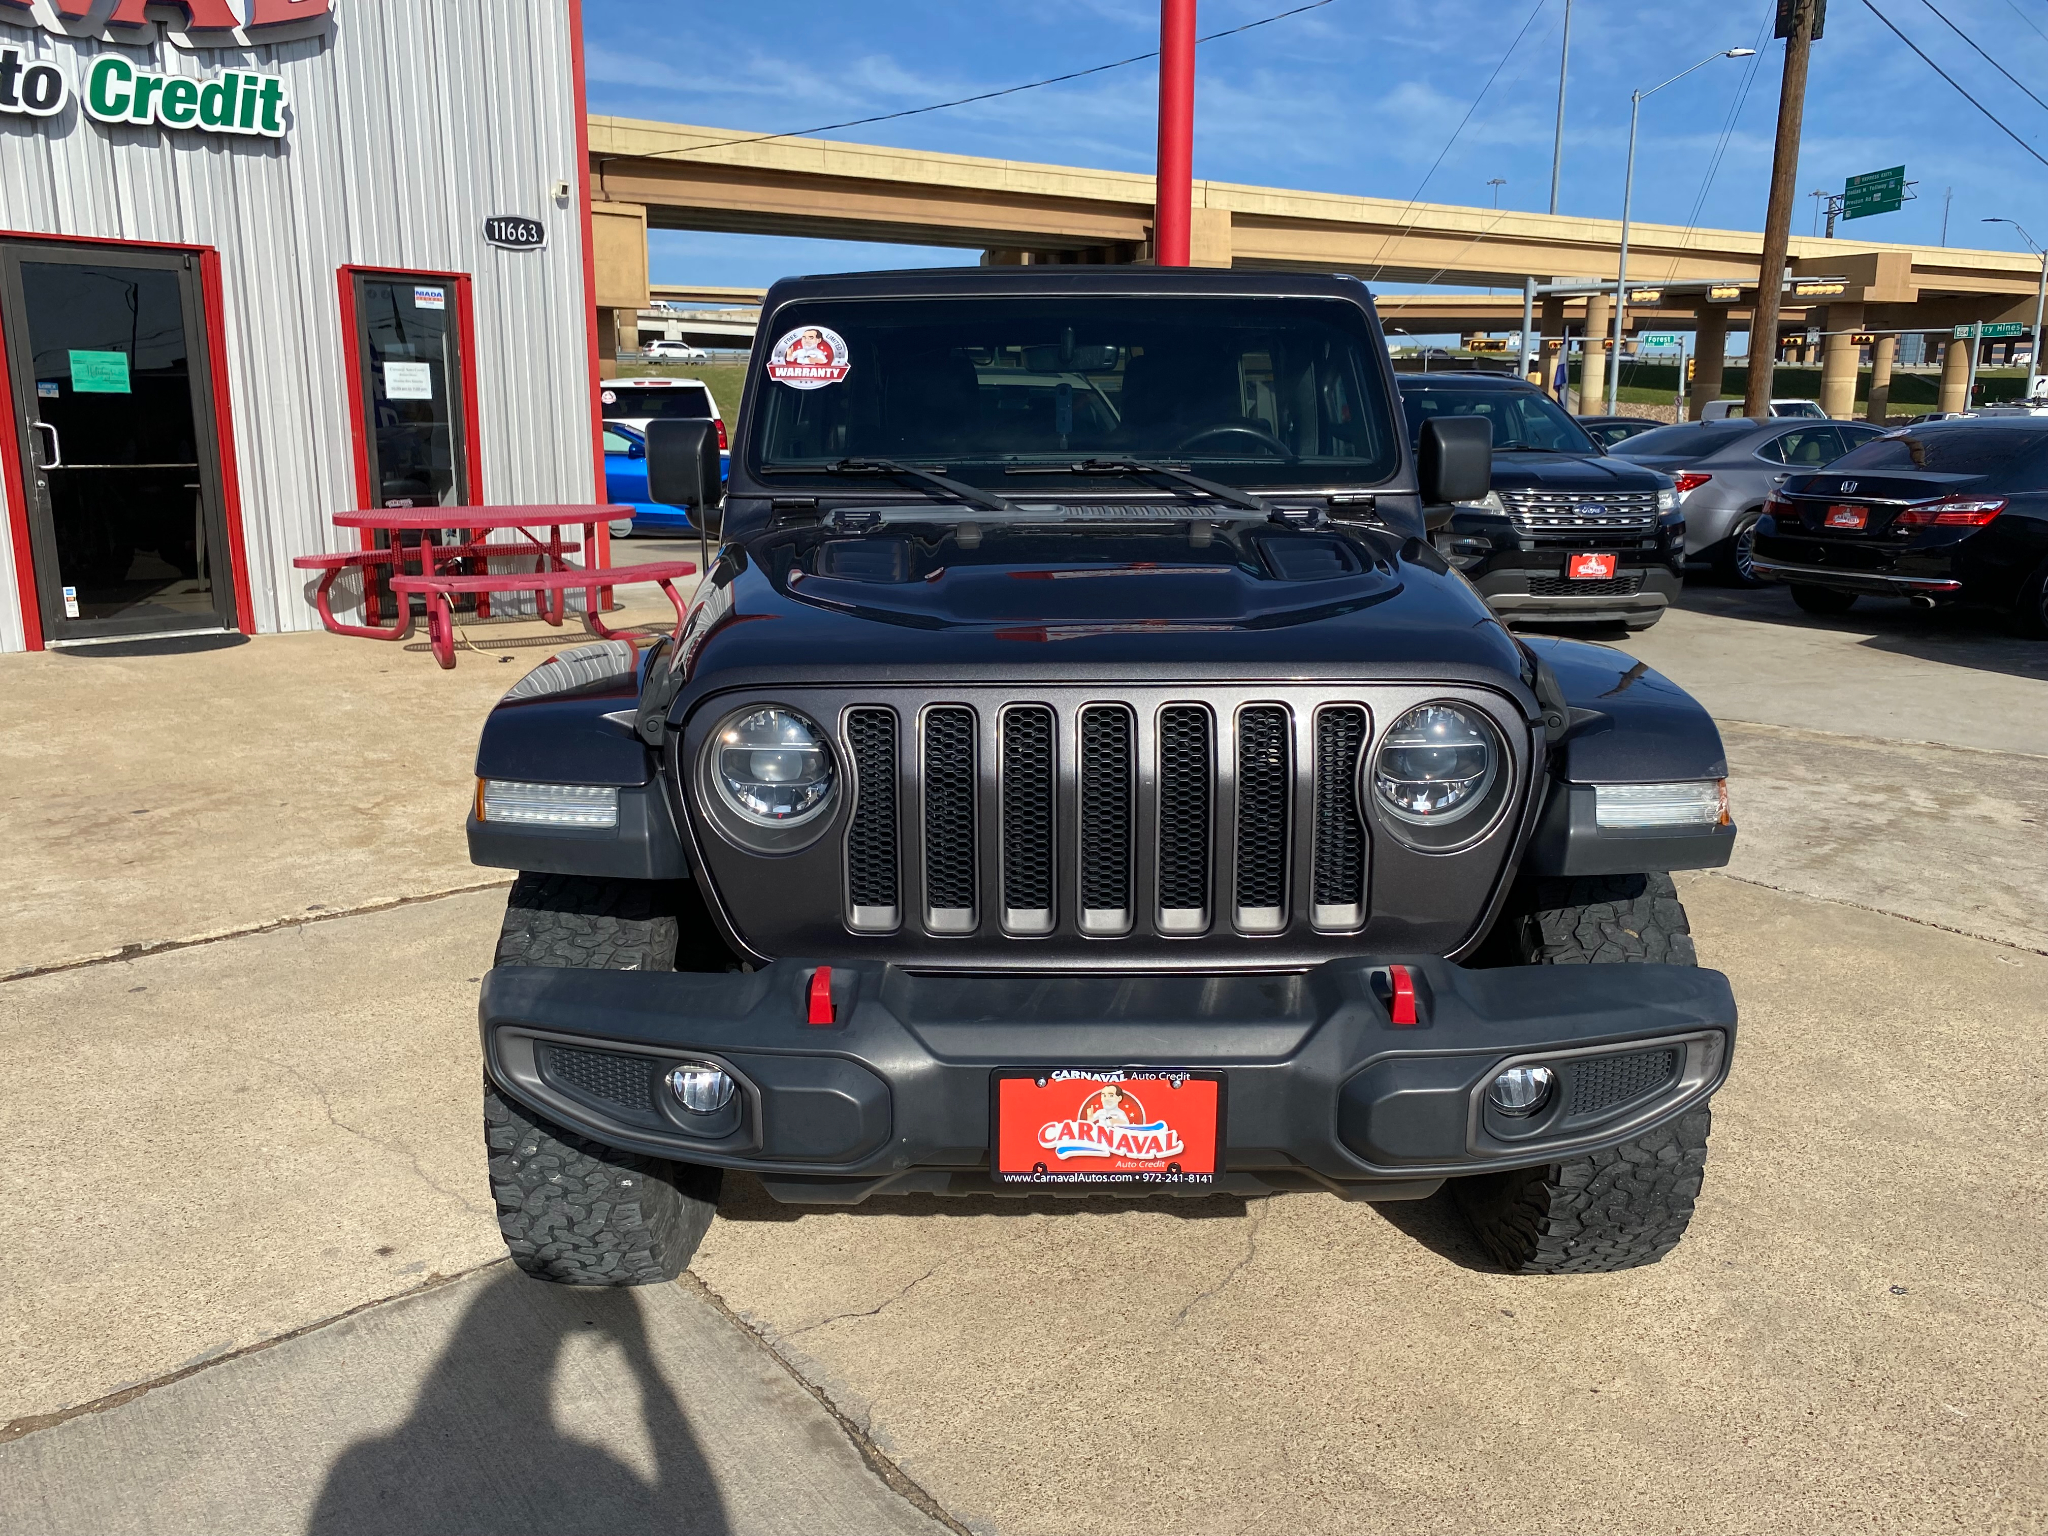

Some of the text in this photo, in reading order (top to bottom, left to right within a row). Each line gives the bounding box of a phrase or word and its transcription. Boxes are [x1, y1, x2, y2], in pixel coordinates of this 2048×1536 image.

[89, 58, 283, 132] Credit
[1869, 183, 1887, 191] Tollway
[493, 221, 537, 242] 11663
[416, 290, 442, 298] NIADA
[1997, 323, 2021, 332] Hines
[783, 332, 843, 351] FREE LIMITED
[775, 367, 840, 378] WARRANTY
[1581, 505, 1601, 514] Ford
[1051, 1069, 1191, 1083] CARNAVAL Auto Credit
[1038, 1120, 1182, 1154] CARNAVAL
[1115, 1160, 1166, 1168] Auto Credit
[1003, 1172, 1213, 1184] www.CarnavalAutos.com 972-241-8141
